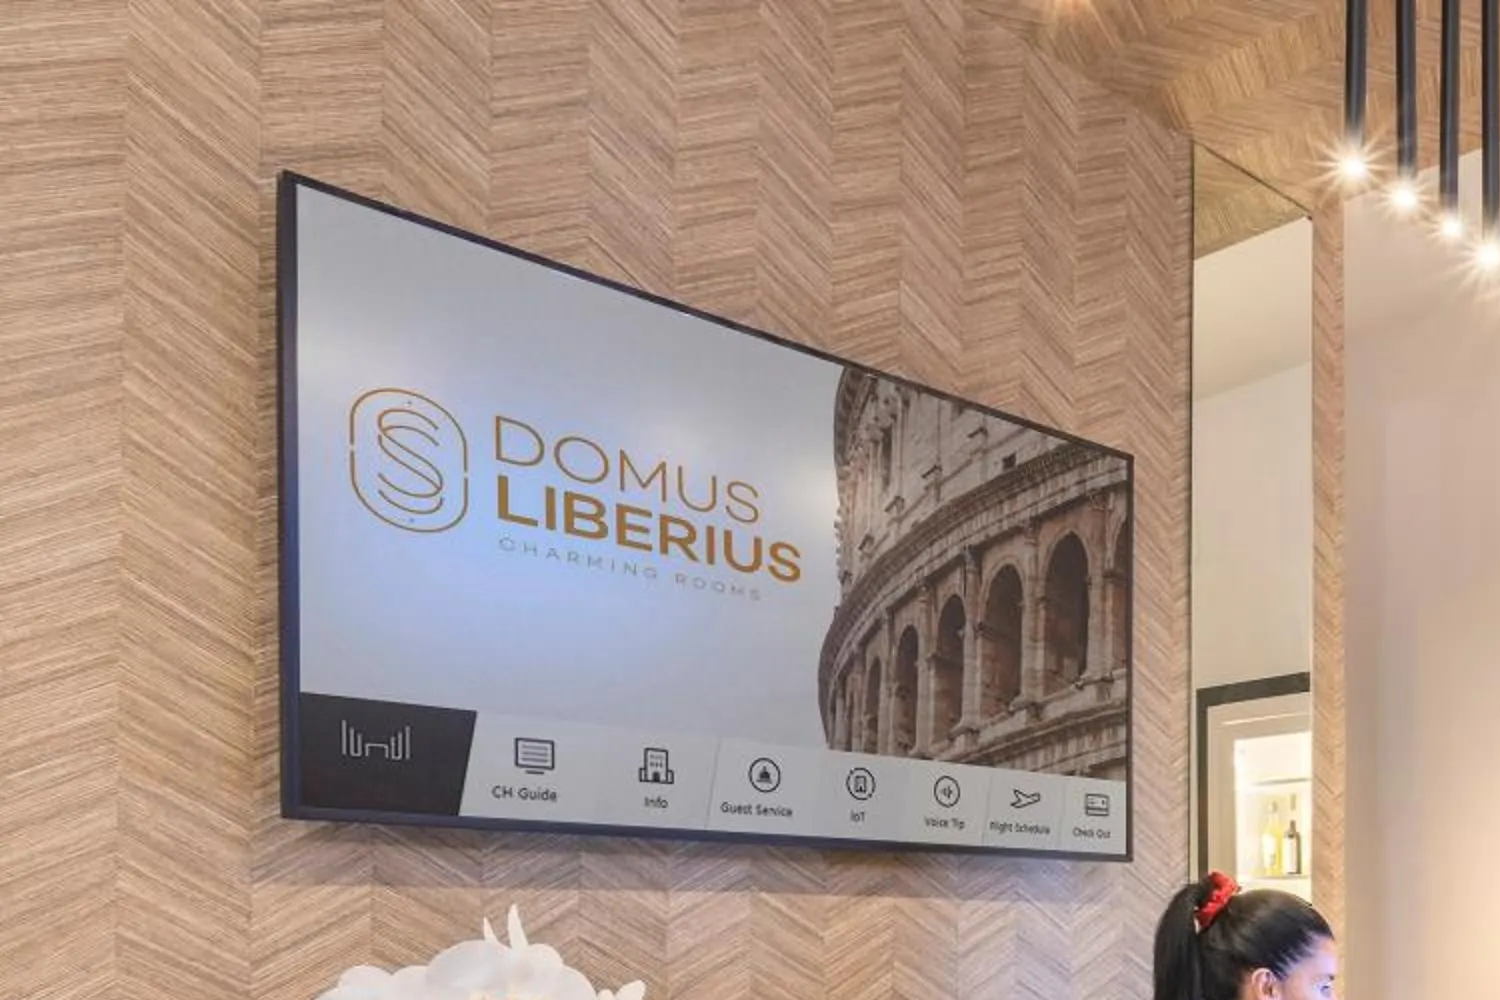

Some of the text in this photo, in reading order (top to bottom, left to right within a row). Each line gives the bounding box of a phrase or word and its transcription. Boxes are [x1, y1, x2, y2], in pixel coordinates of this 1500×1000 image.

[495, 414, 760, 523] DOMUS
[497, 475, 801, 583] LIBERIUS
[499, 536, 762, 601] CHARMING ROOMS
[491, 784, 558, 802] CH Guide
[644, 796, 669, 809] Info
[720, 801, 793, 817] Guest Service
